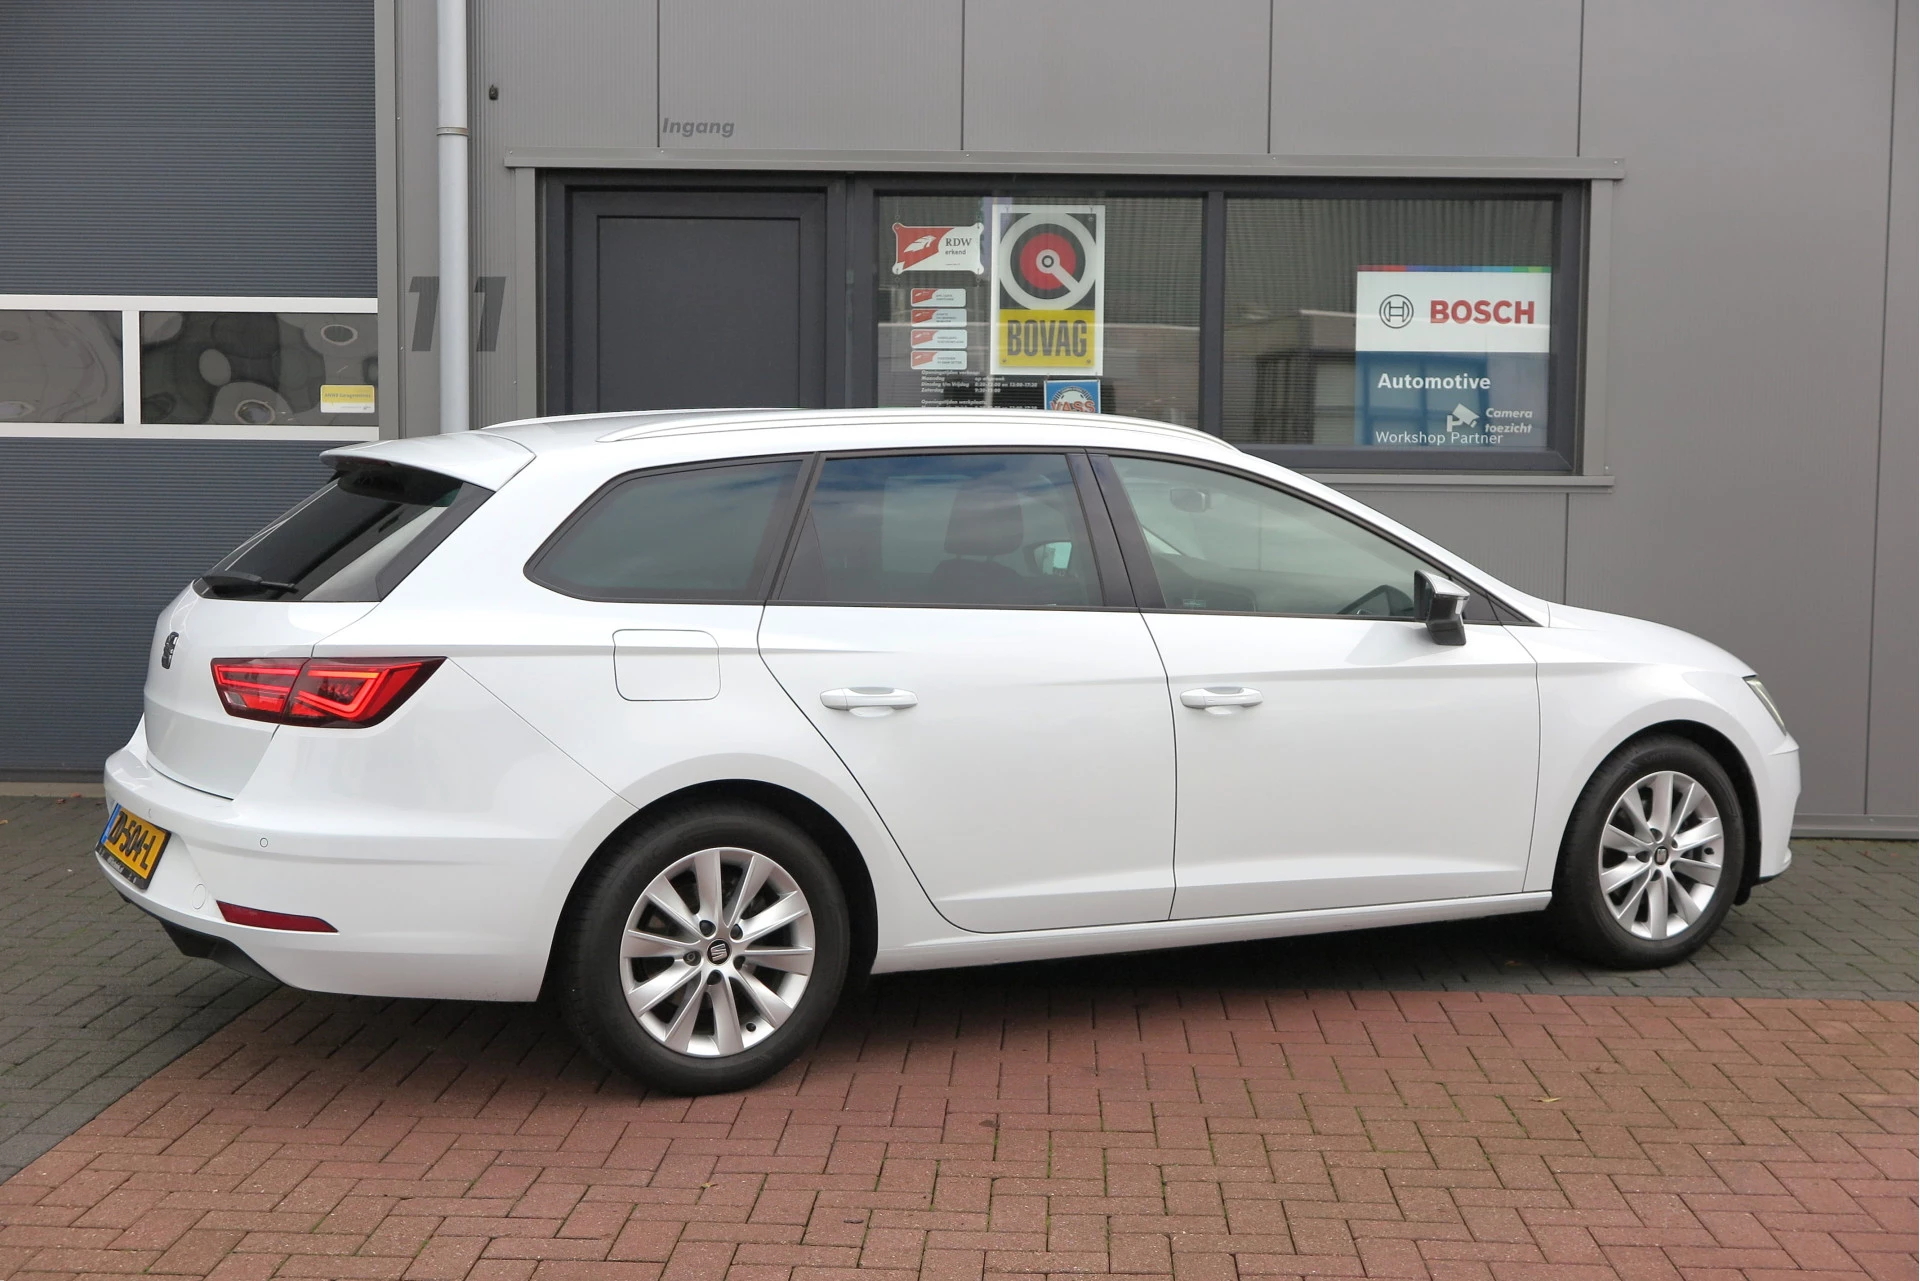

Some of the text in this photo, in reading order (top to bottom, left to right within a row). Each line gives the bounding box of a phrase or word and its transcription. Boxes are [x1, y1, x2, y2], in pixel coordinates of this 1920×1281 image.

[662, 116, 736, 138] Ingang
[945, 237, 973, 247] RDW
[1430, 300, 1536, 324] BOSCH
[1006, 319, 1088, 358] BOVAG
[1377, 373, 1492, 390] Automotive
[1050, 400, 1095, 413] VASS
[1485, 407, 1533, 419] Camera
[1484, 422, 1533, 434] toezicht
[1375, 431, 1504, 446] Workshop Partner
